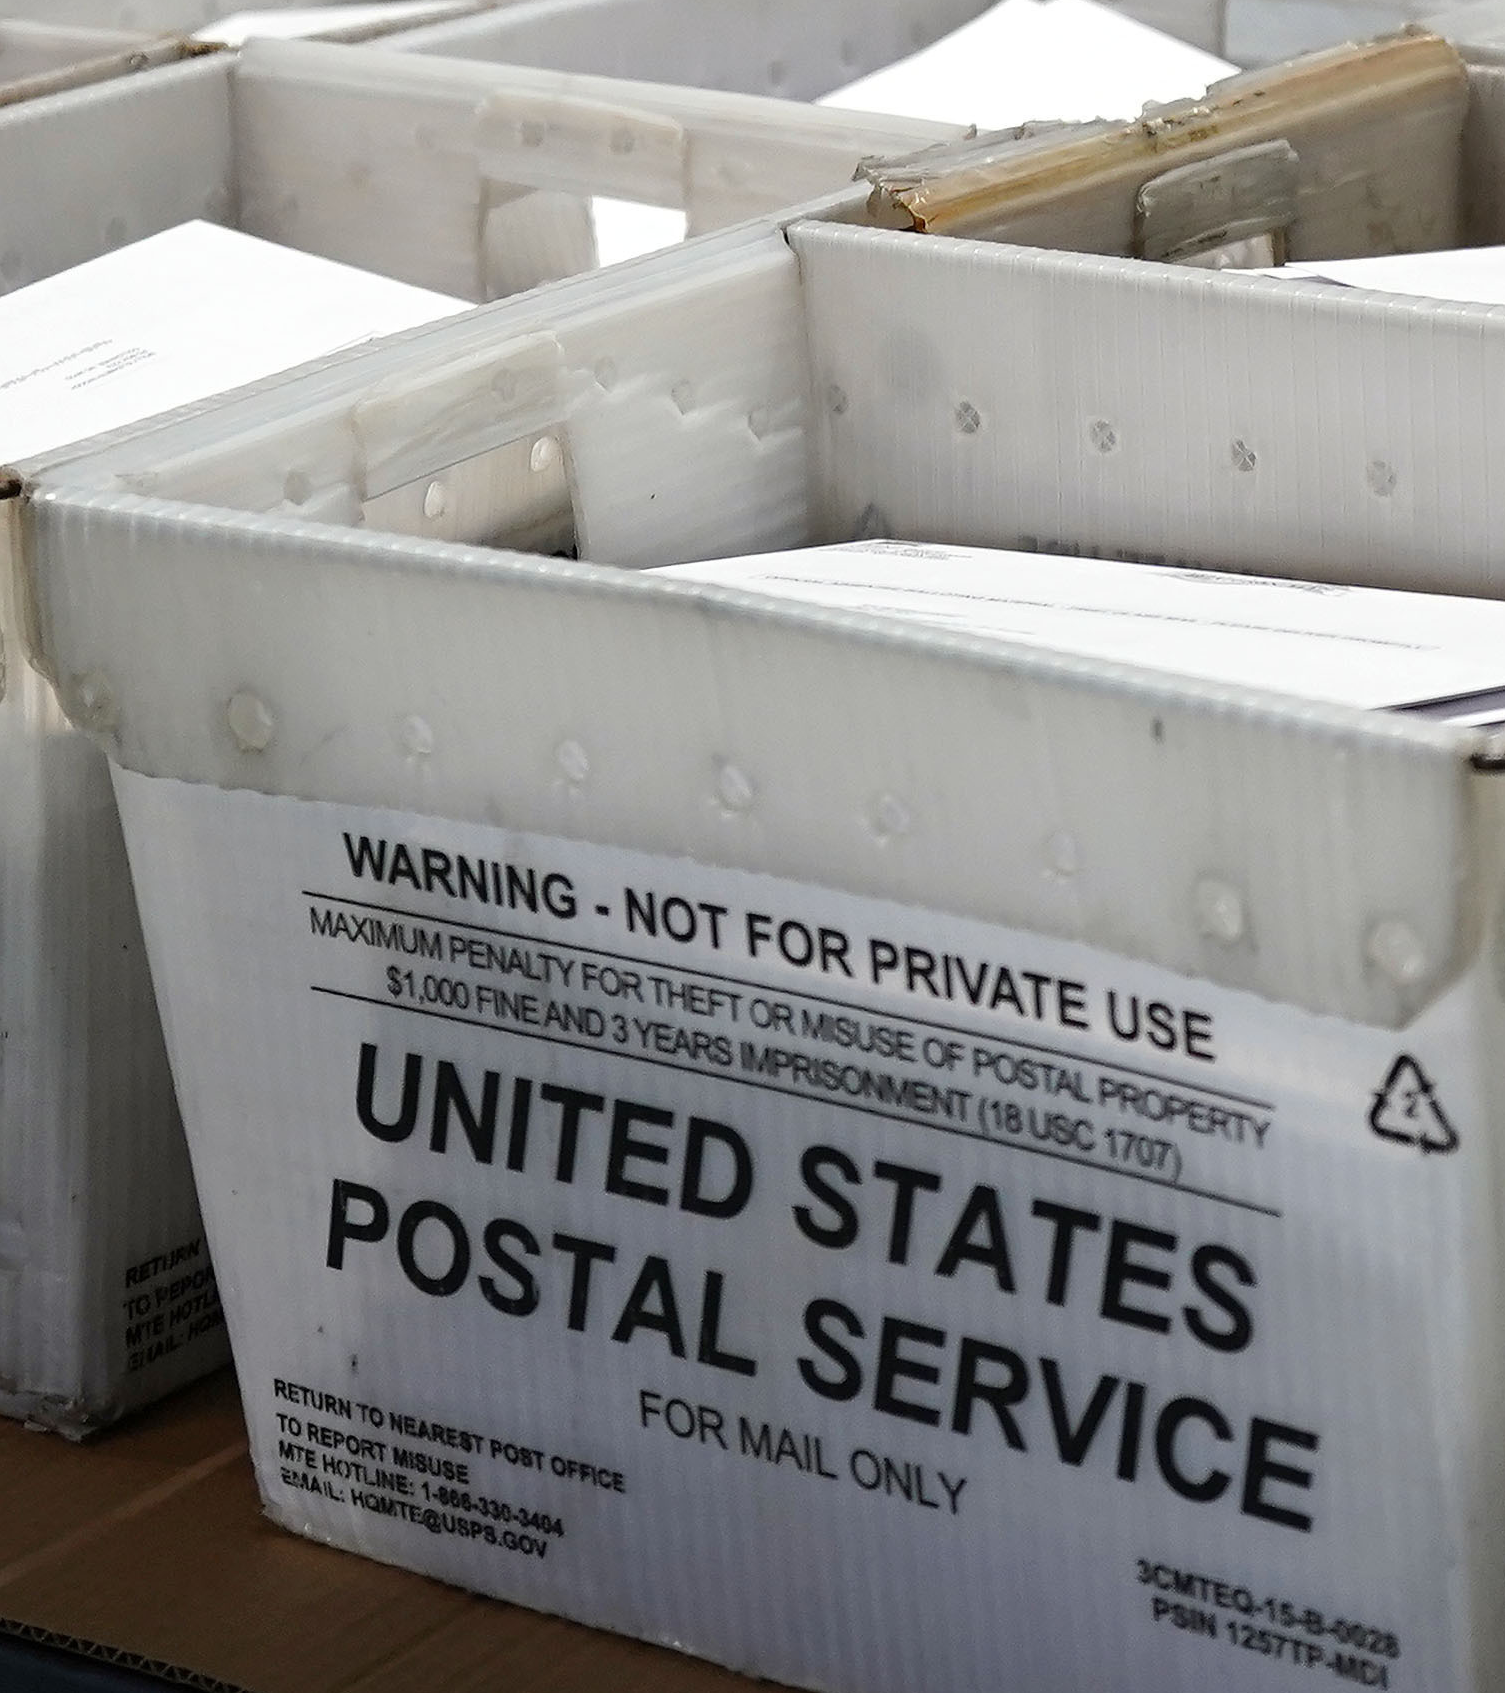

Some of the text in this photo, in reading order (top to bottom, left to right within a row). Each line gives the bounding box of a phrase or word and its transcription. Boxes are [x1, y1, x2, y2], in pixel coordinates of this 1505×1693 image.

[343, 832, 578, 920] WARNING
[624, 887, 727, 949] NOT
[746, 912, 853, 978] FOR
[869, 939, 1090, 1031] PRIVATE
[1107, 989, 1216, 1062] USE
[309, 907, 1272, 1152] MAXIMUM PENALTY FOR THEFT OR MISUSE OF POSTAL PROPERTY
[386, 964, 1182, 1185] $1,000 FINE AND 3 YEARS IMPRISONMENT (18 USC 1707)
[355, 1043, 1259, 1355] UNITED STATES
[123, 1293, 152, 1320] TO
[125, 1238, 202, 1289] RETURN
[124, 1313, 165, 1349] MTE
[326, 1178, 1320, 1533] POSTAL SERVICE
[273, 1378, 626, 1494] RETURN TO NEAREST POST OFFICE
[275, 1412, 470, 1485] TO REPORT MISUSE
[278, 1440, 316, 1469] MTE
[321, 1453, 415, 1496] HOTLINE:
[279, 1466, 345, 1503] EMAIL:
[639, 1391, 967, 1515] FOR MAIL ONLY
